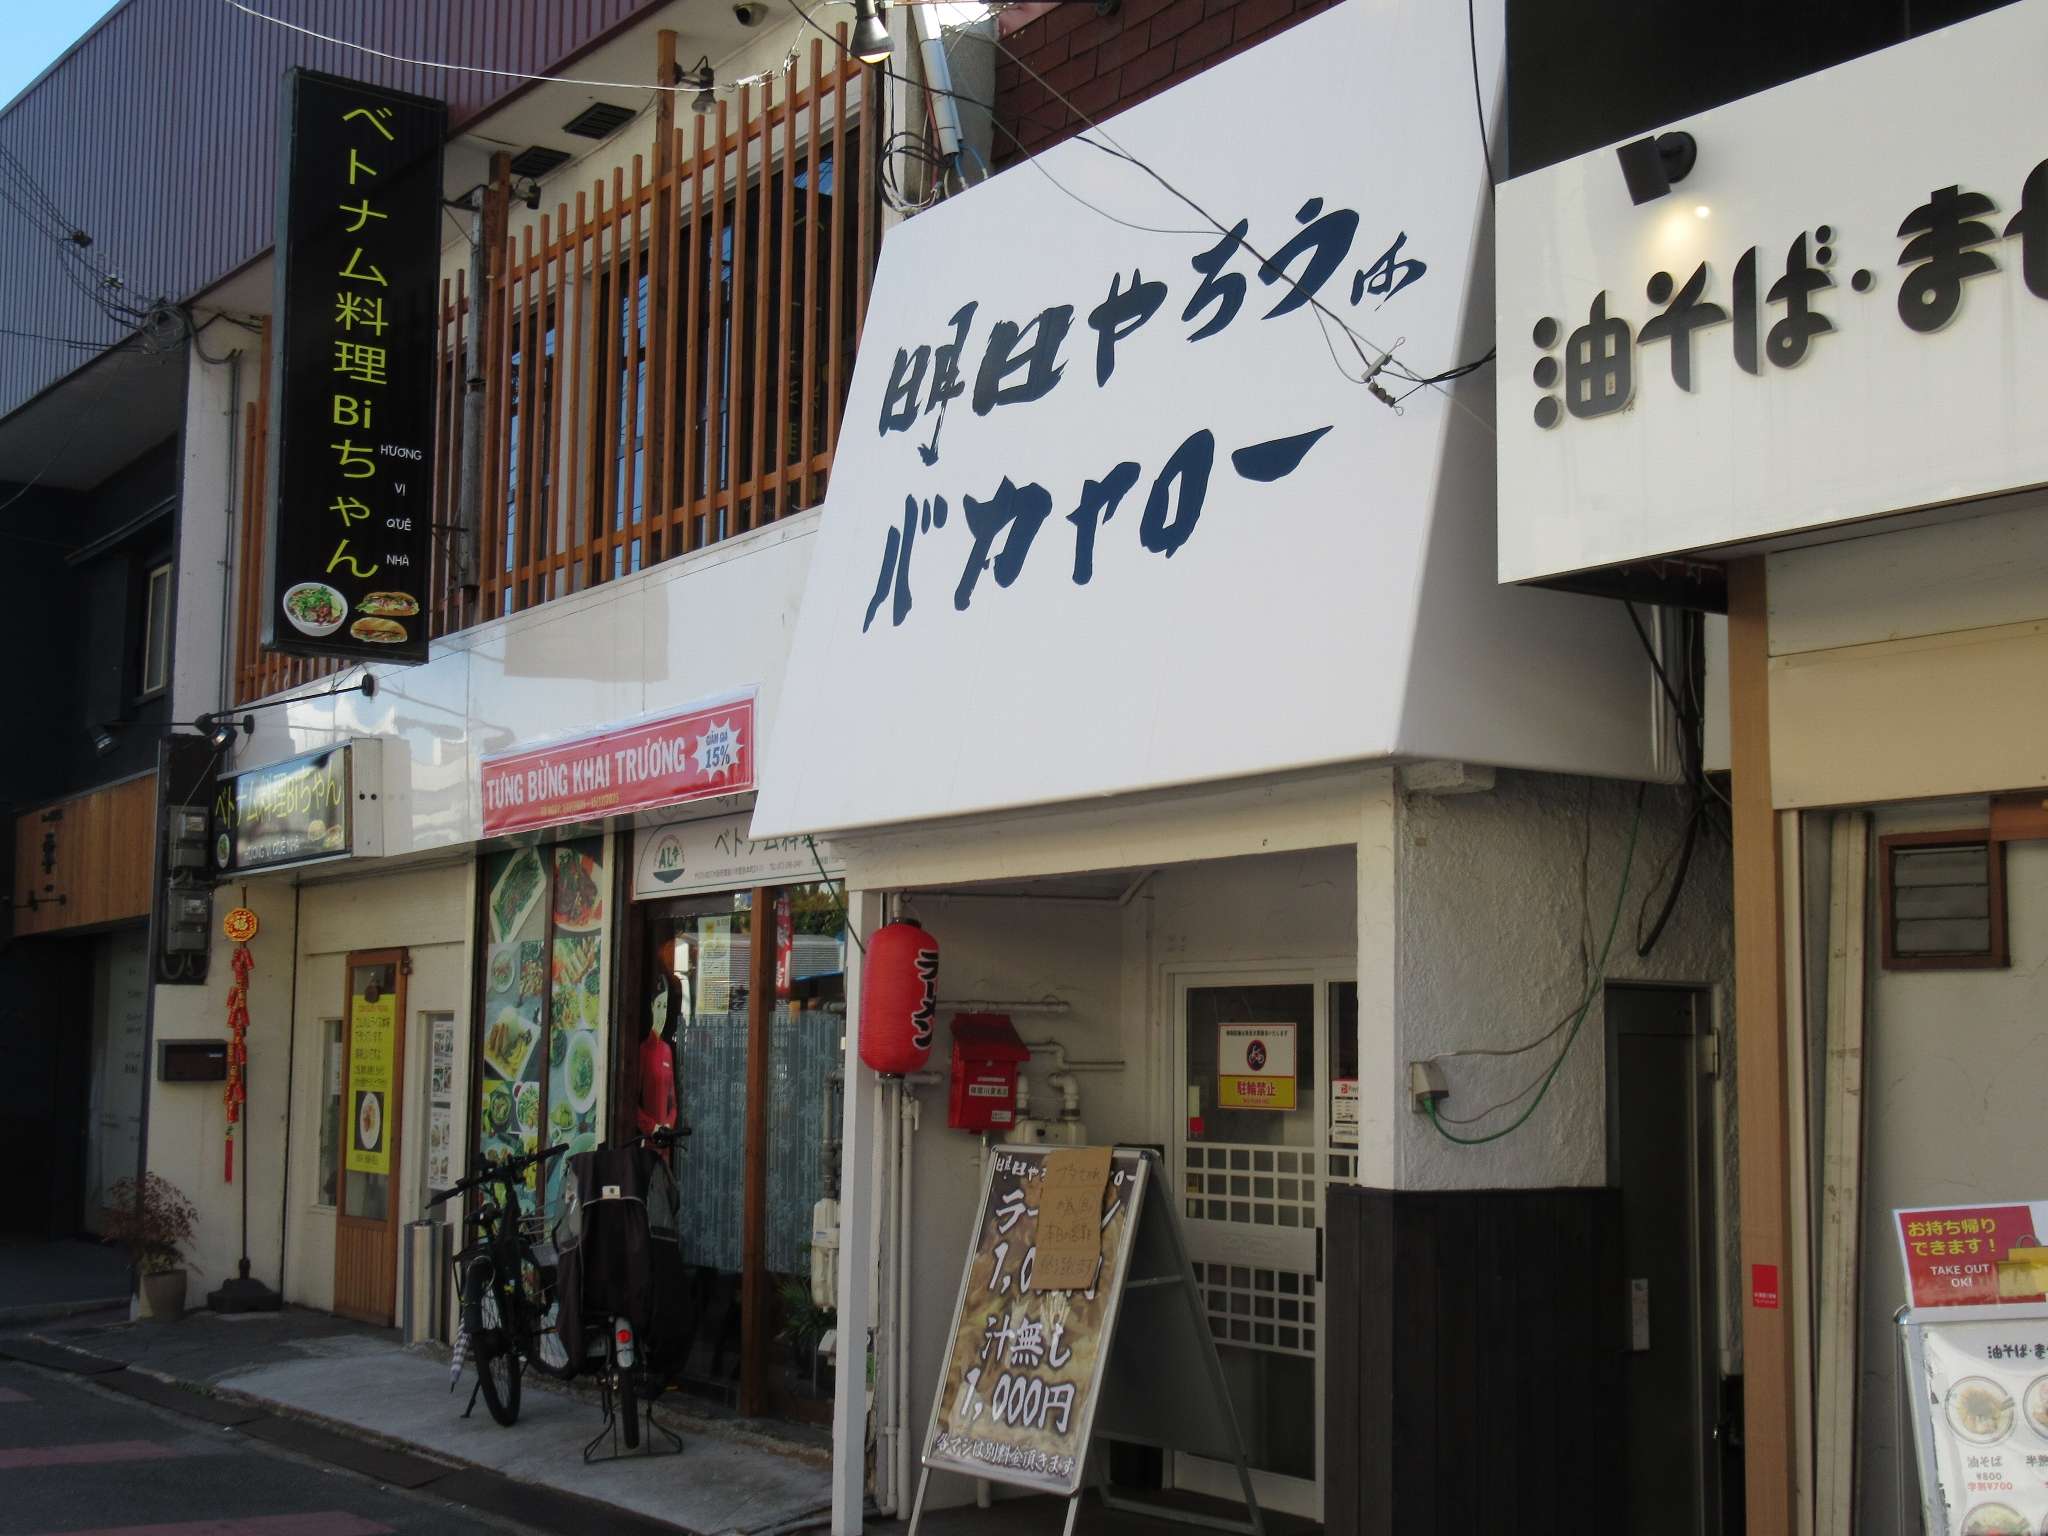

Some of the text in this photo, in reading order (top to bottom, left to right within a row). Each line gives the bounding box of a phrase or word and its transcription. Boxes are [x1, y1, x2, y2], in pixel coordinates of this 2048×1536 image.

[327, 107, 395, 578] ベトナム料理Biちゃん
[863, 425, 1334, 633] バカヤロー
[705, 744, 731, 768] 15%
[573, 754, 611, 794] KHAI
[1907, 1218, 1997, 1238] お持ち帰り
[1930, 1263, 1990, 1276] TAKE OUT
[1951, 1277, 1973, 1288] OK!
[982, 1314, 1072, 1368] 汁無し
[1987, 1343, 2048, 1360] 油そば・ま
[960, 1367, 1075, 1433] 1,000円
